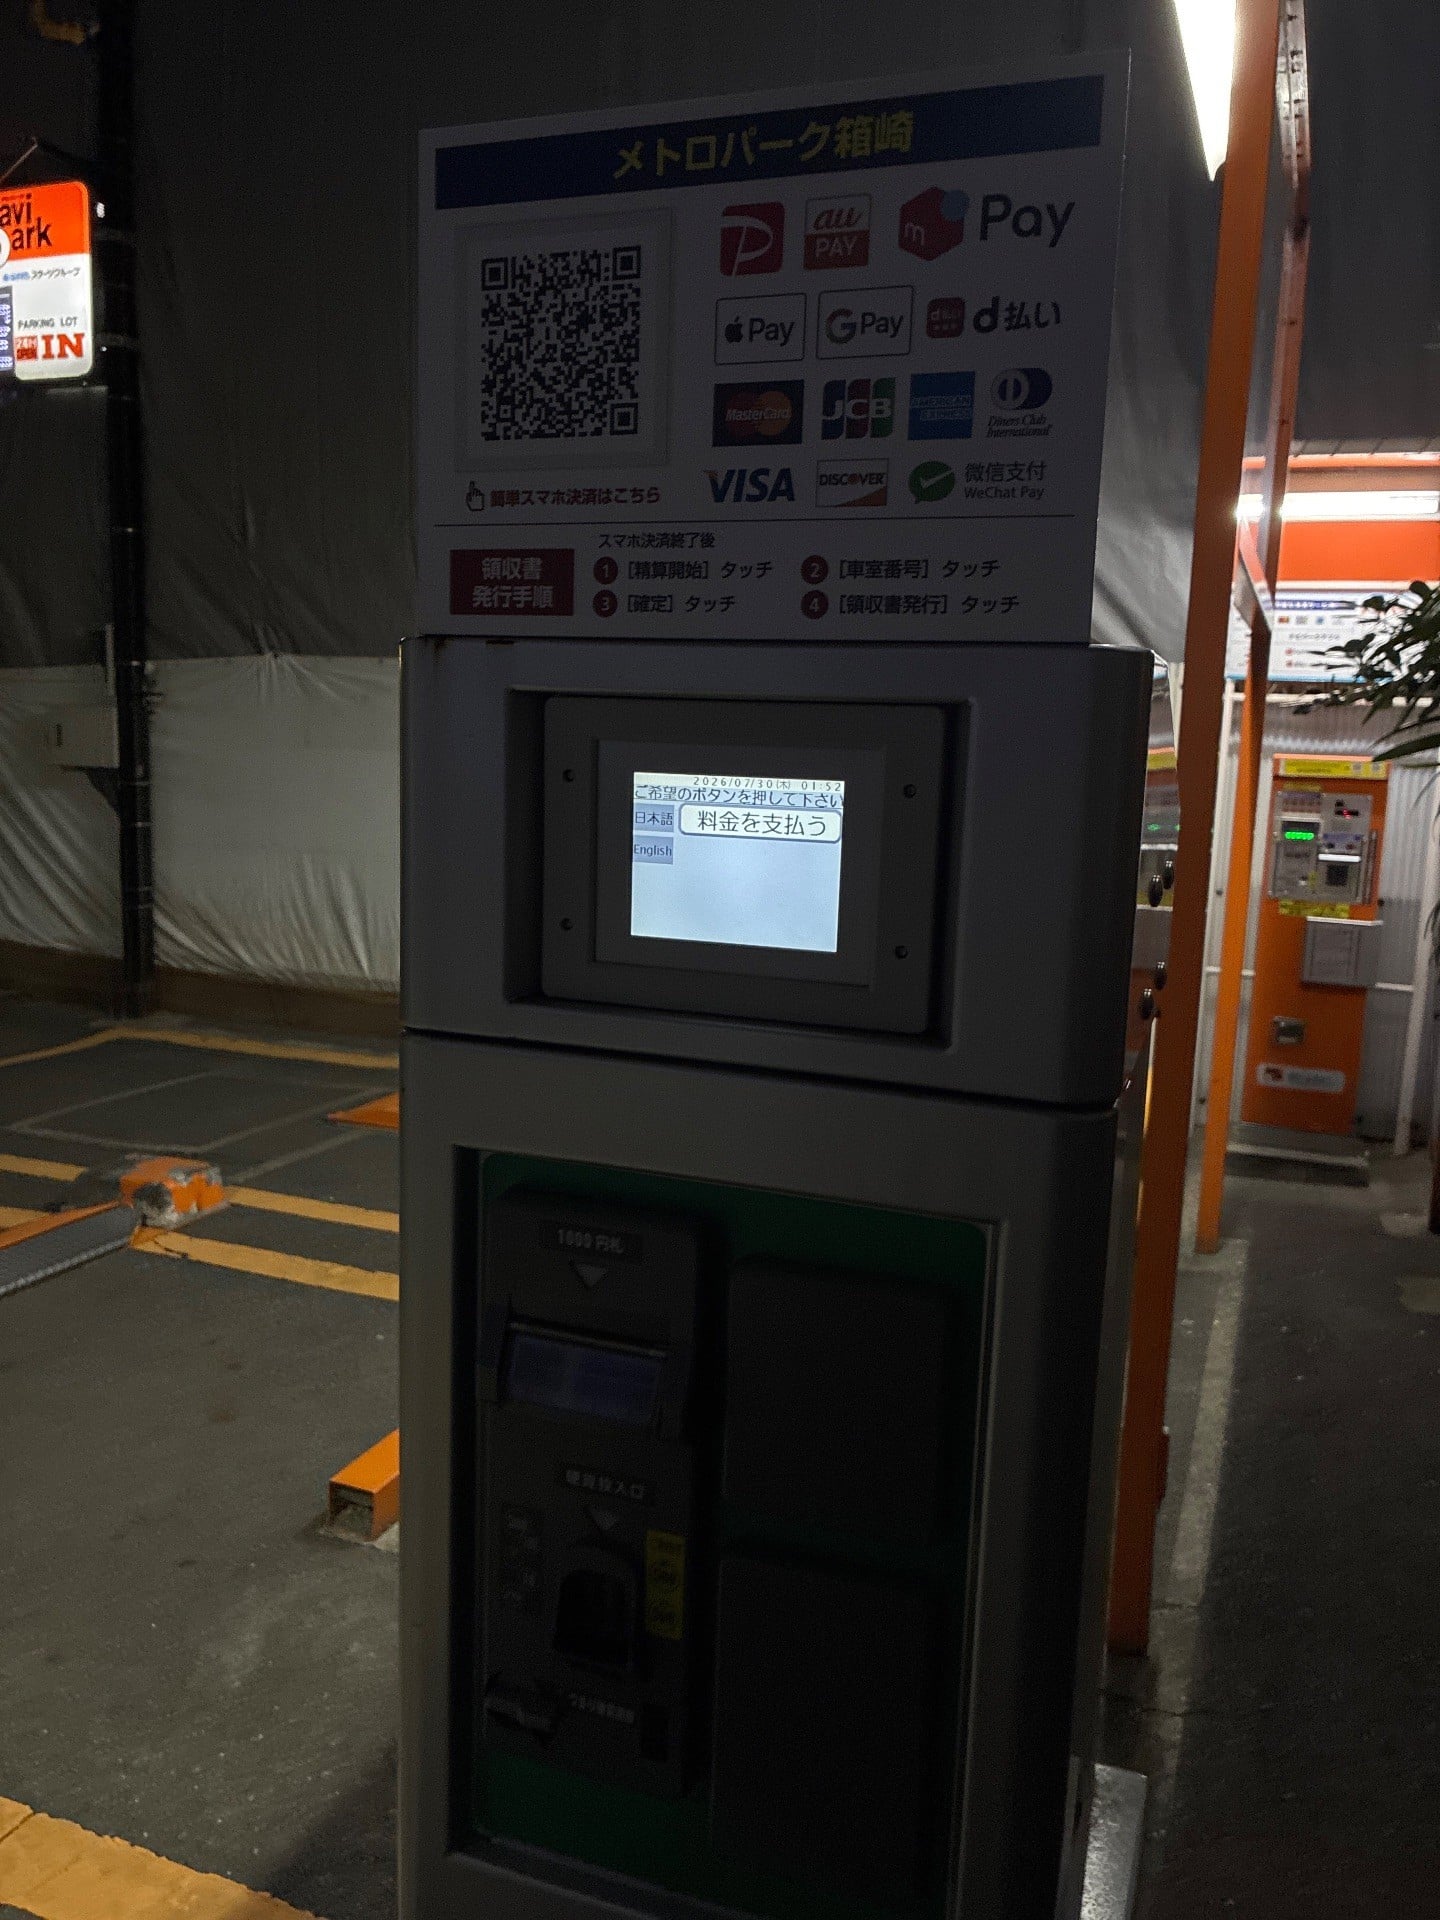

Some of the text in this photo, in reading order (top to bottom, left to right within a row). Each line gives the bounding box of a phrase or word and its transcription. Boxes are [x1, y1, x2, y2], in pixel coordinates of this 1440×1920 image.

[612, 109, 914, 180] メトロパーク箱崎
[814, 206, 862, 230] au
[980, 194, 1074, 248] Pay
[815, 236, 857, 258] PAY
[18, 316, 78, 331] PARKING LOT
[861, 310, 904, 339] Pay
[973, 296, 1061, 333] d払い
[749, 316, 794, 347] Pay
[42, 333, 85, 360] IN
[725, 406, 794, 422] MasterCard
[822, 398, 893, 421] JCB
[986, 423, 1053, 439] International
[987, 414, 1048, 428] Diners Club
[819, 472, 887, 487] DISCOVER
[964, 460, 1047, 483] 微信支付
[703, 468, 796, 503] VISA
[964, 485, 1046, 502] WeChat Pay
[490, 487, 661, 509] 簡単スマホ決済はこちら
[598, 532, 716, 550] スマホ決済終了後
[481, 556, 544, 581] 領収書
[720, 561, 773, 580] タッチ
[942, 559, 1000, 579] タッチ
[471, 584, 554, 609] 発行手順
[684, 594, 736, 613] タッチ
[960, 595, 1020, 614] タッチ
[634, 784, 845, 808] ご希望のボタンを押して下さい
[801, 779, 842, 792] 01:52
[635, 811, 674, 826] 日本語
[697, 809, 827, 837] 料金を支払う
[634, 843, 673, 857] English
